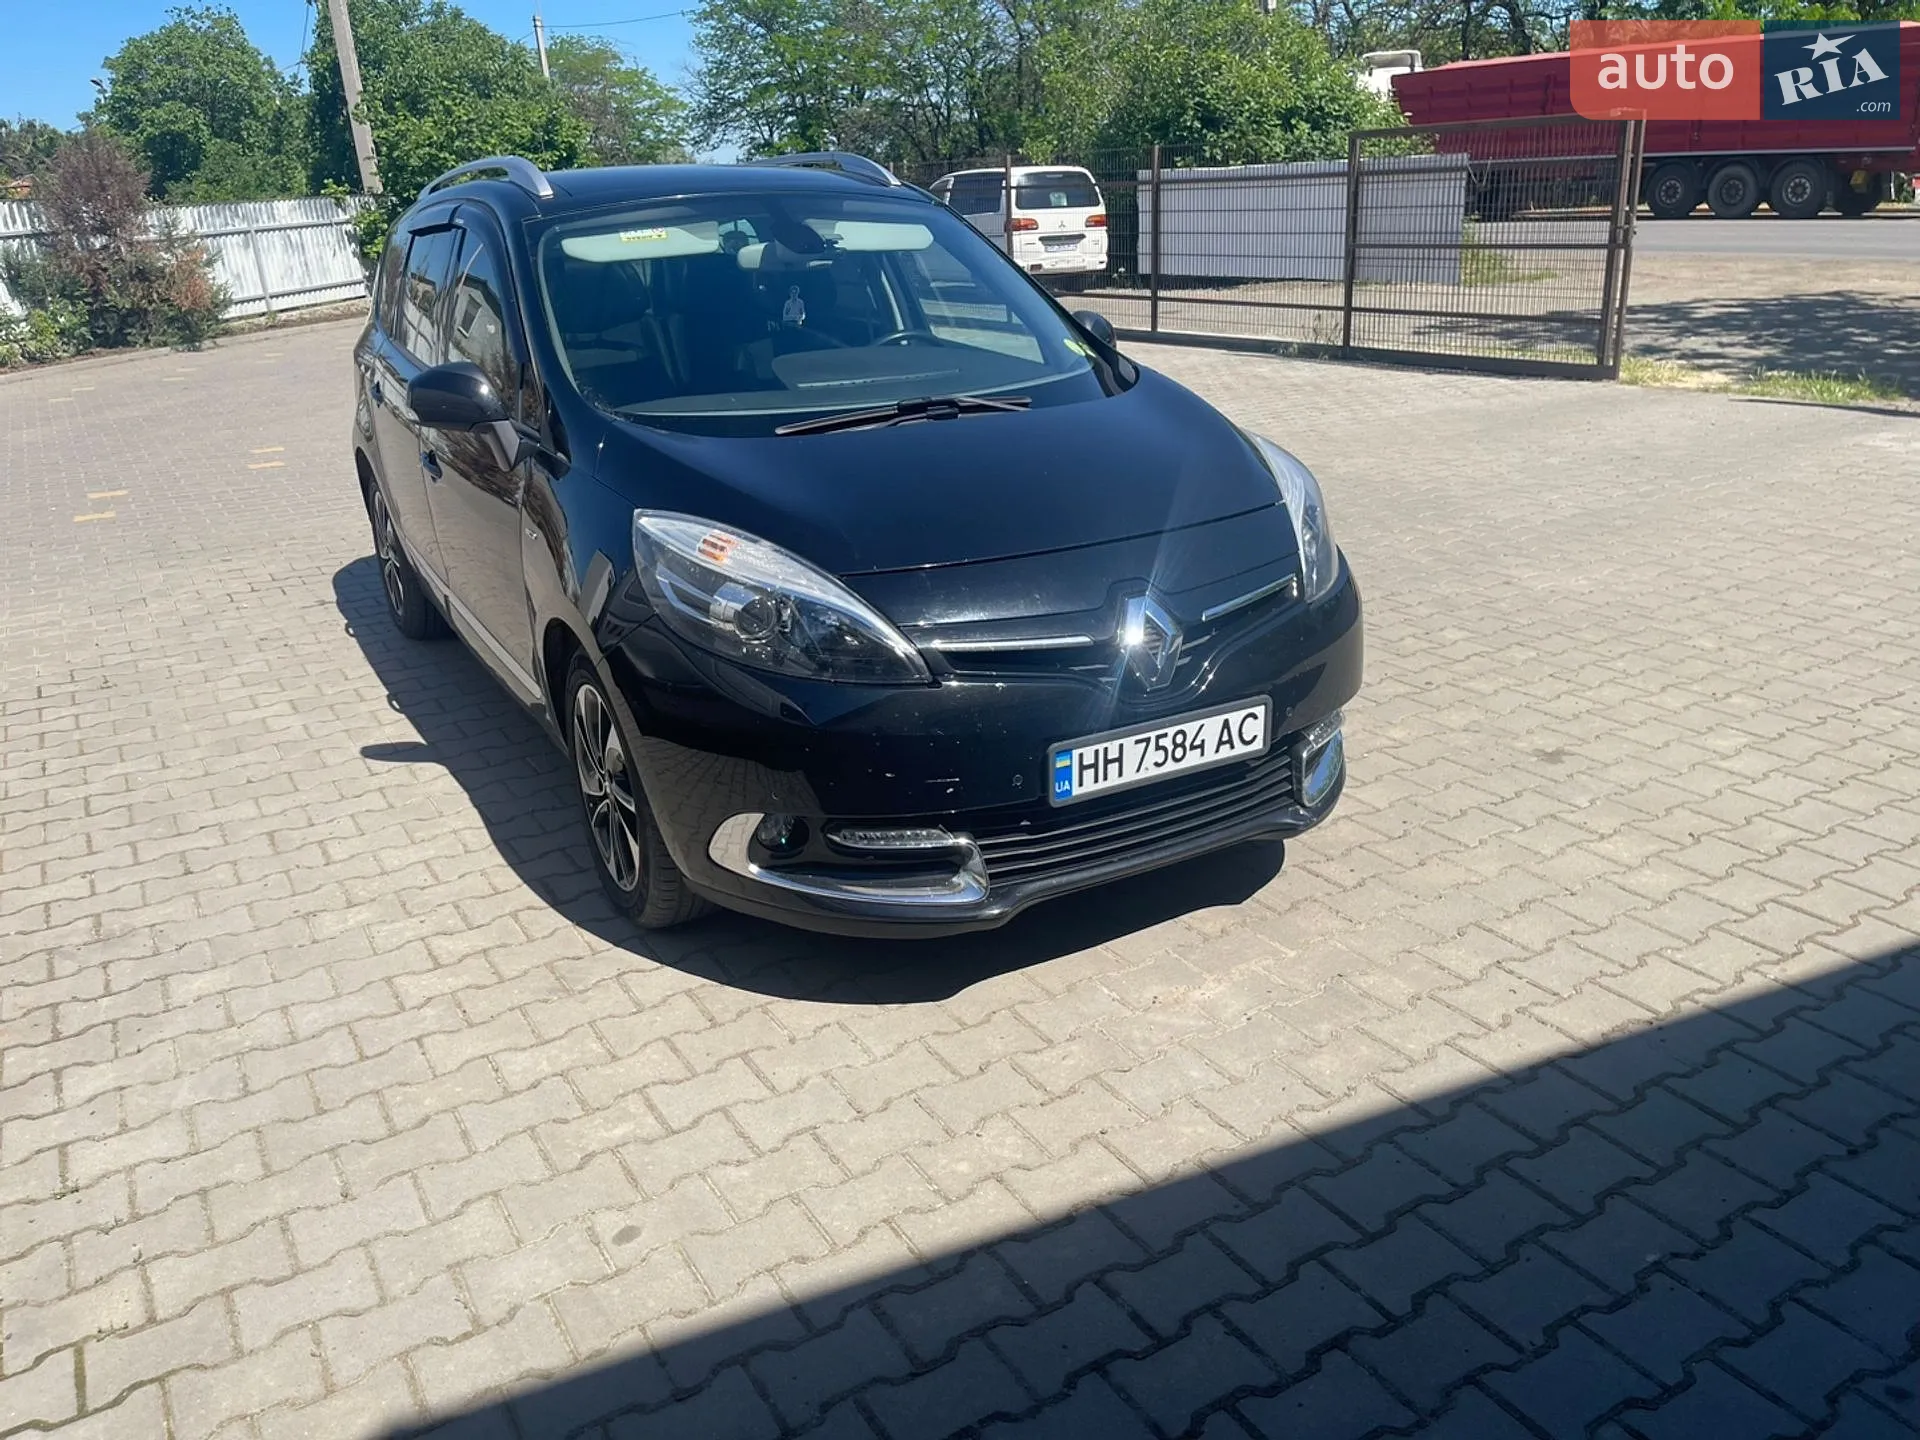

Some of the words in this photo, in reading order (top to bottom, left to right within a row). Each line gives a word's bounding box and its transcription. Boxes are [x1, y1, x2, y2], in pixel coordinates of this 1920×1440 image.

[1078, 743, 1123, 787] HH
[1134, 723, 1206, 773] 7584
[1215, 712, 1259, 754] AC
[1055, 782, 1070, 792] UA
